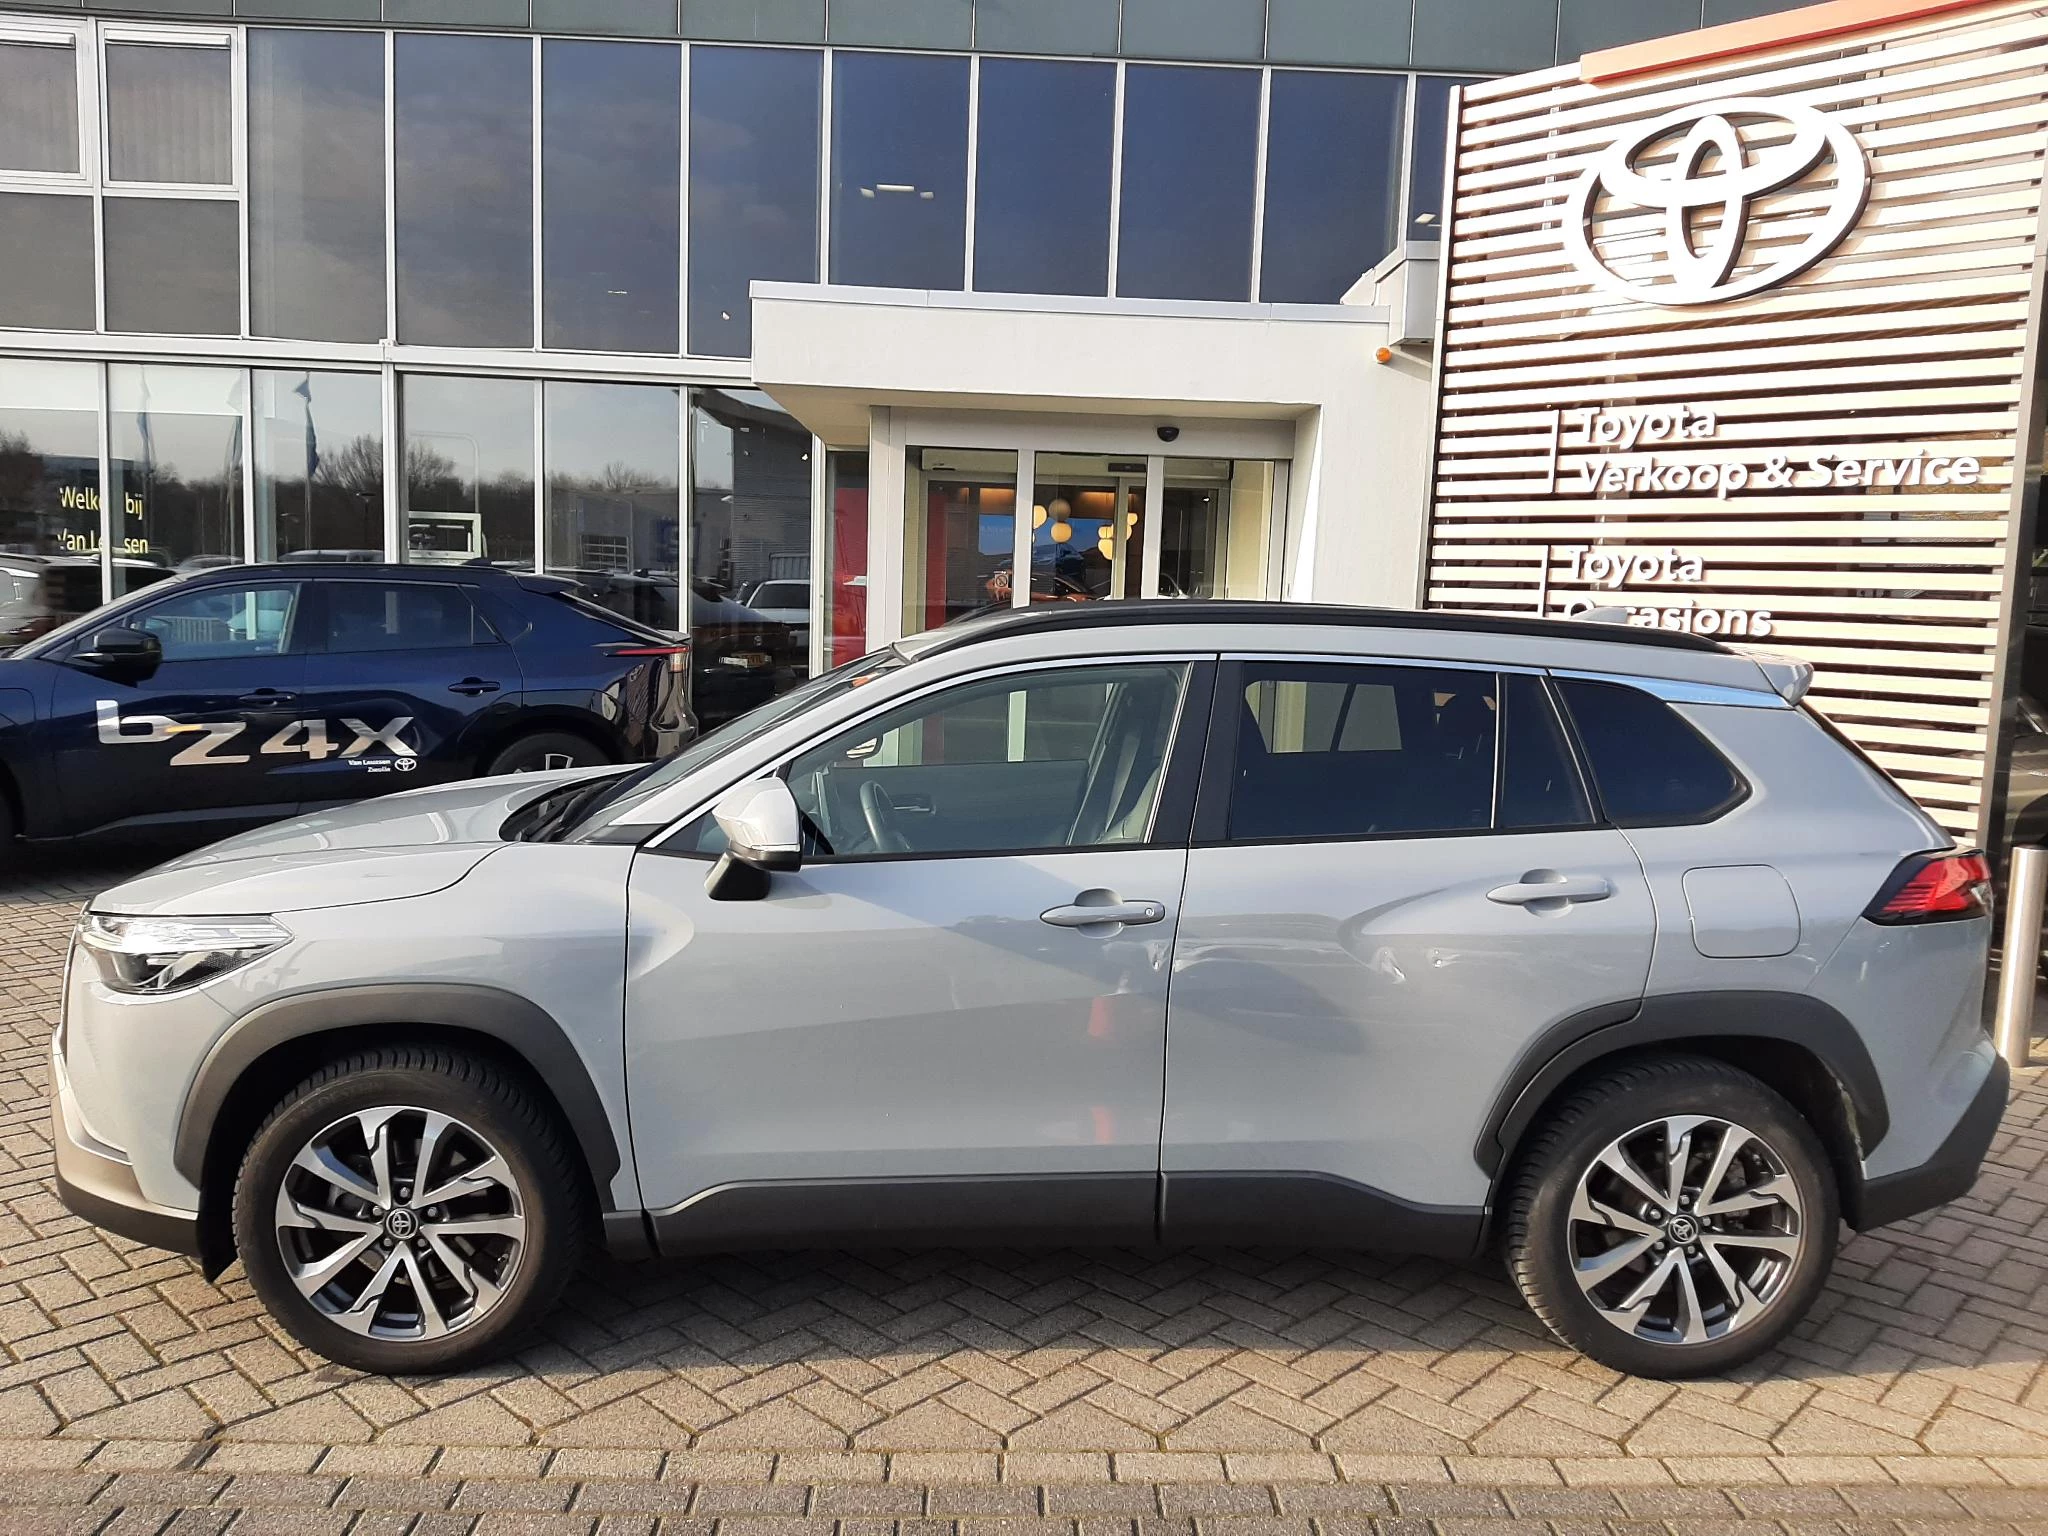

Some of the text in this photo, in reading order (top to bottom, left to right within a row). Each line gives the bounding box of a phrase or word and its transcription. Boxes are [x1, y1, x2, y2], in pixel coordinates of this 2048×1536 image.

[1578, 404, 1716, 450] Toyota
[1579, 450, 1981, 500] Verkoop & Service
[60, 486, 143, 520] Welk bij
[57, 528, 86, 551] Van
[1565, 544, 1704, 589] Toyota
[1564, 598, 1772, 637] Oasions
